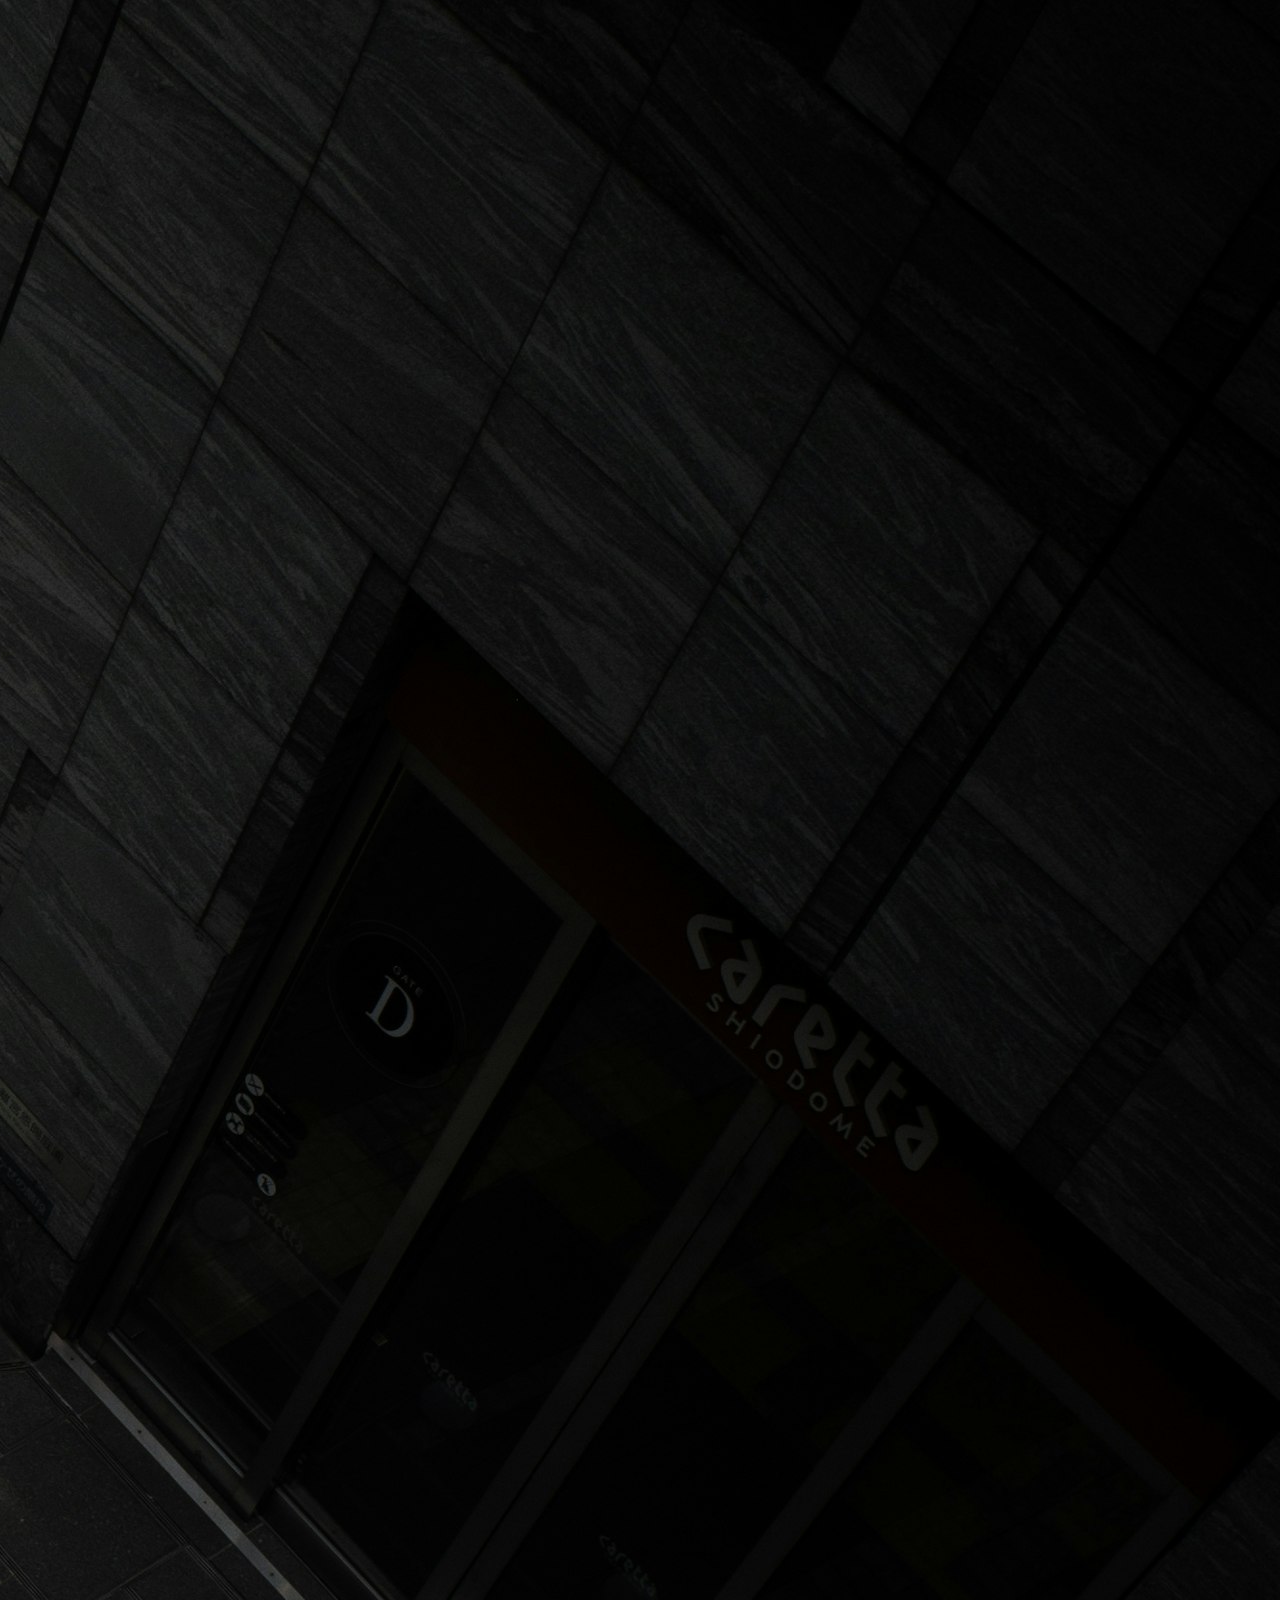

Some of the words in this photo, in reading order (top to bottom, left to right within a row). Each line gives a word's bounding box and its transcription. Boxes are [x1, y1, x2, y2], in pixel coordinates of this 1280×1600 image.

[364, 974, 415, 1038] D
[686, 913, 940, 1172] caretta
[706, 991, 876, 1159] SHIODOME
[423, 1351, 478, 1412] caretta
[599, 1534, 657, 1597] caretta
